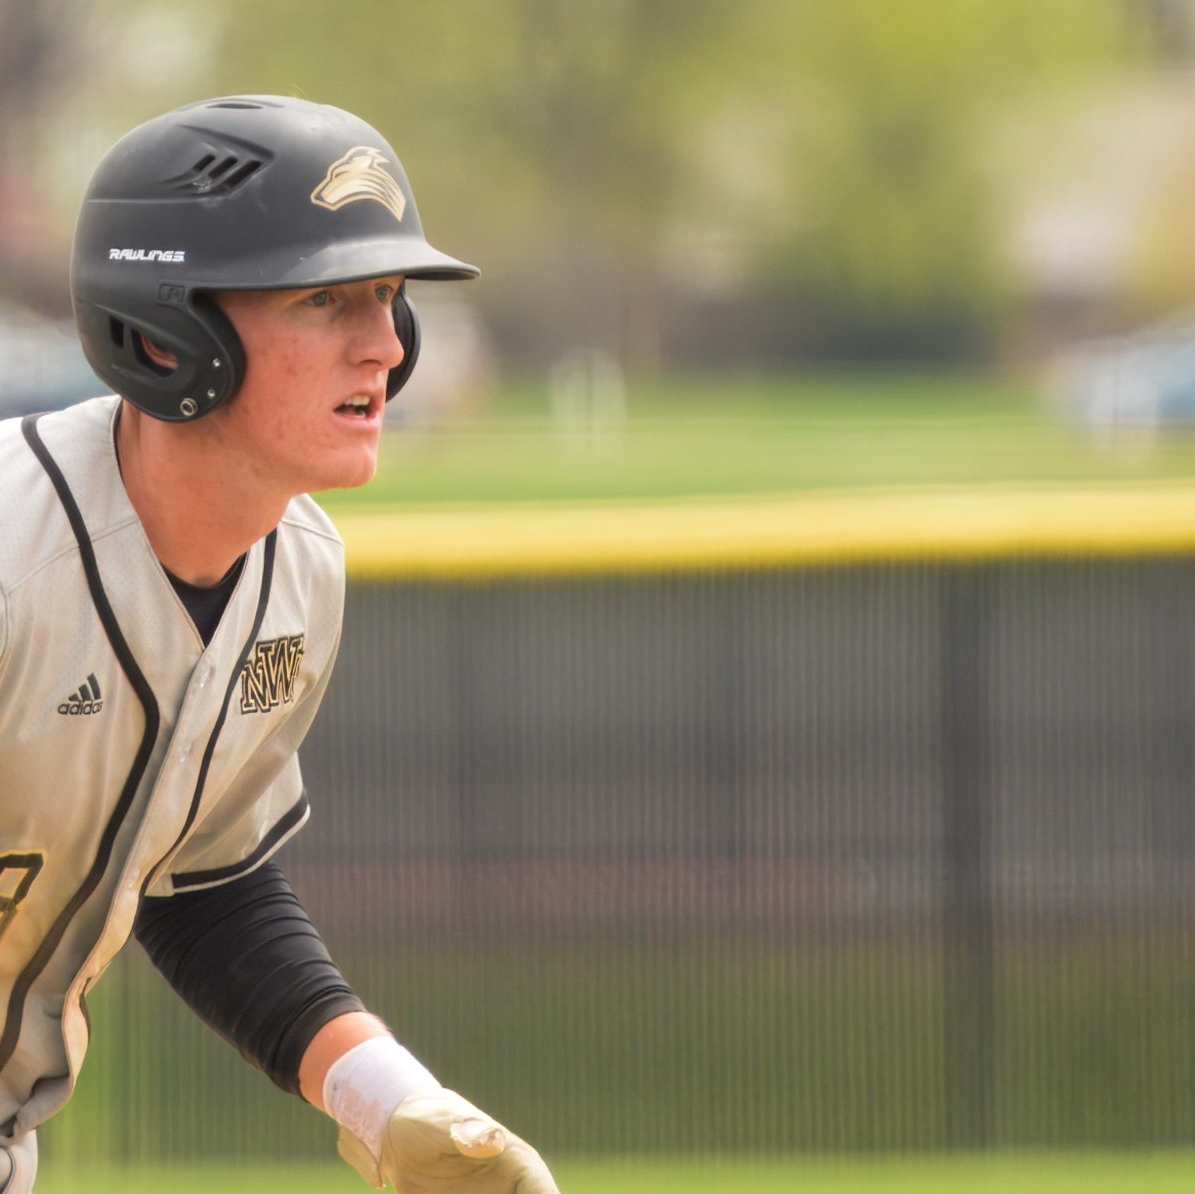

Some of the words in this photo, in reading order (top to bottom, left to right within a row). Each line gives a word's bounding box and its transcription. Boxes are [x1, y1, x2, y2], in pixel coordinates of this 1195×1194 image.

[109, 248, 185, 262] RAWLINGS
[240, 633, 304, 715] NW
[57, 700, 103, 715] adidas
